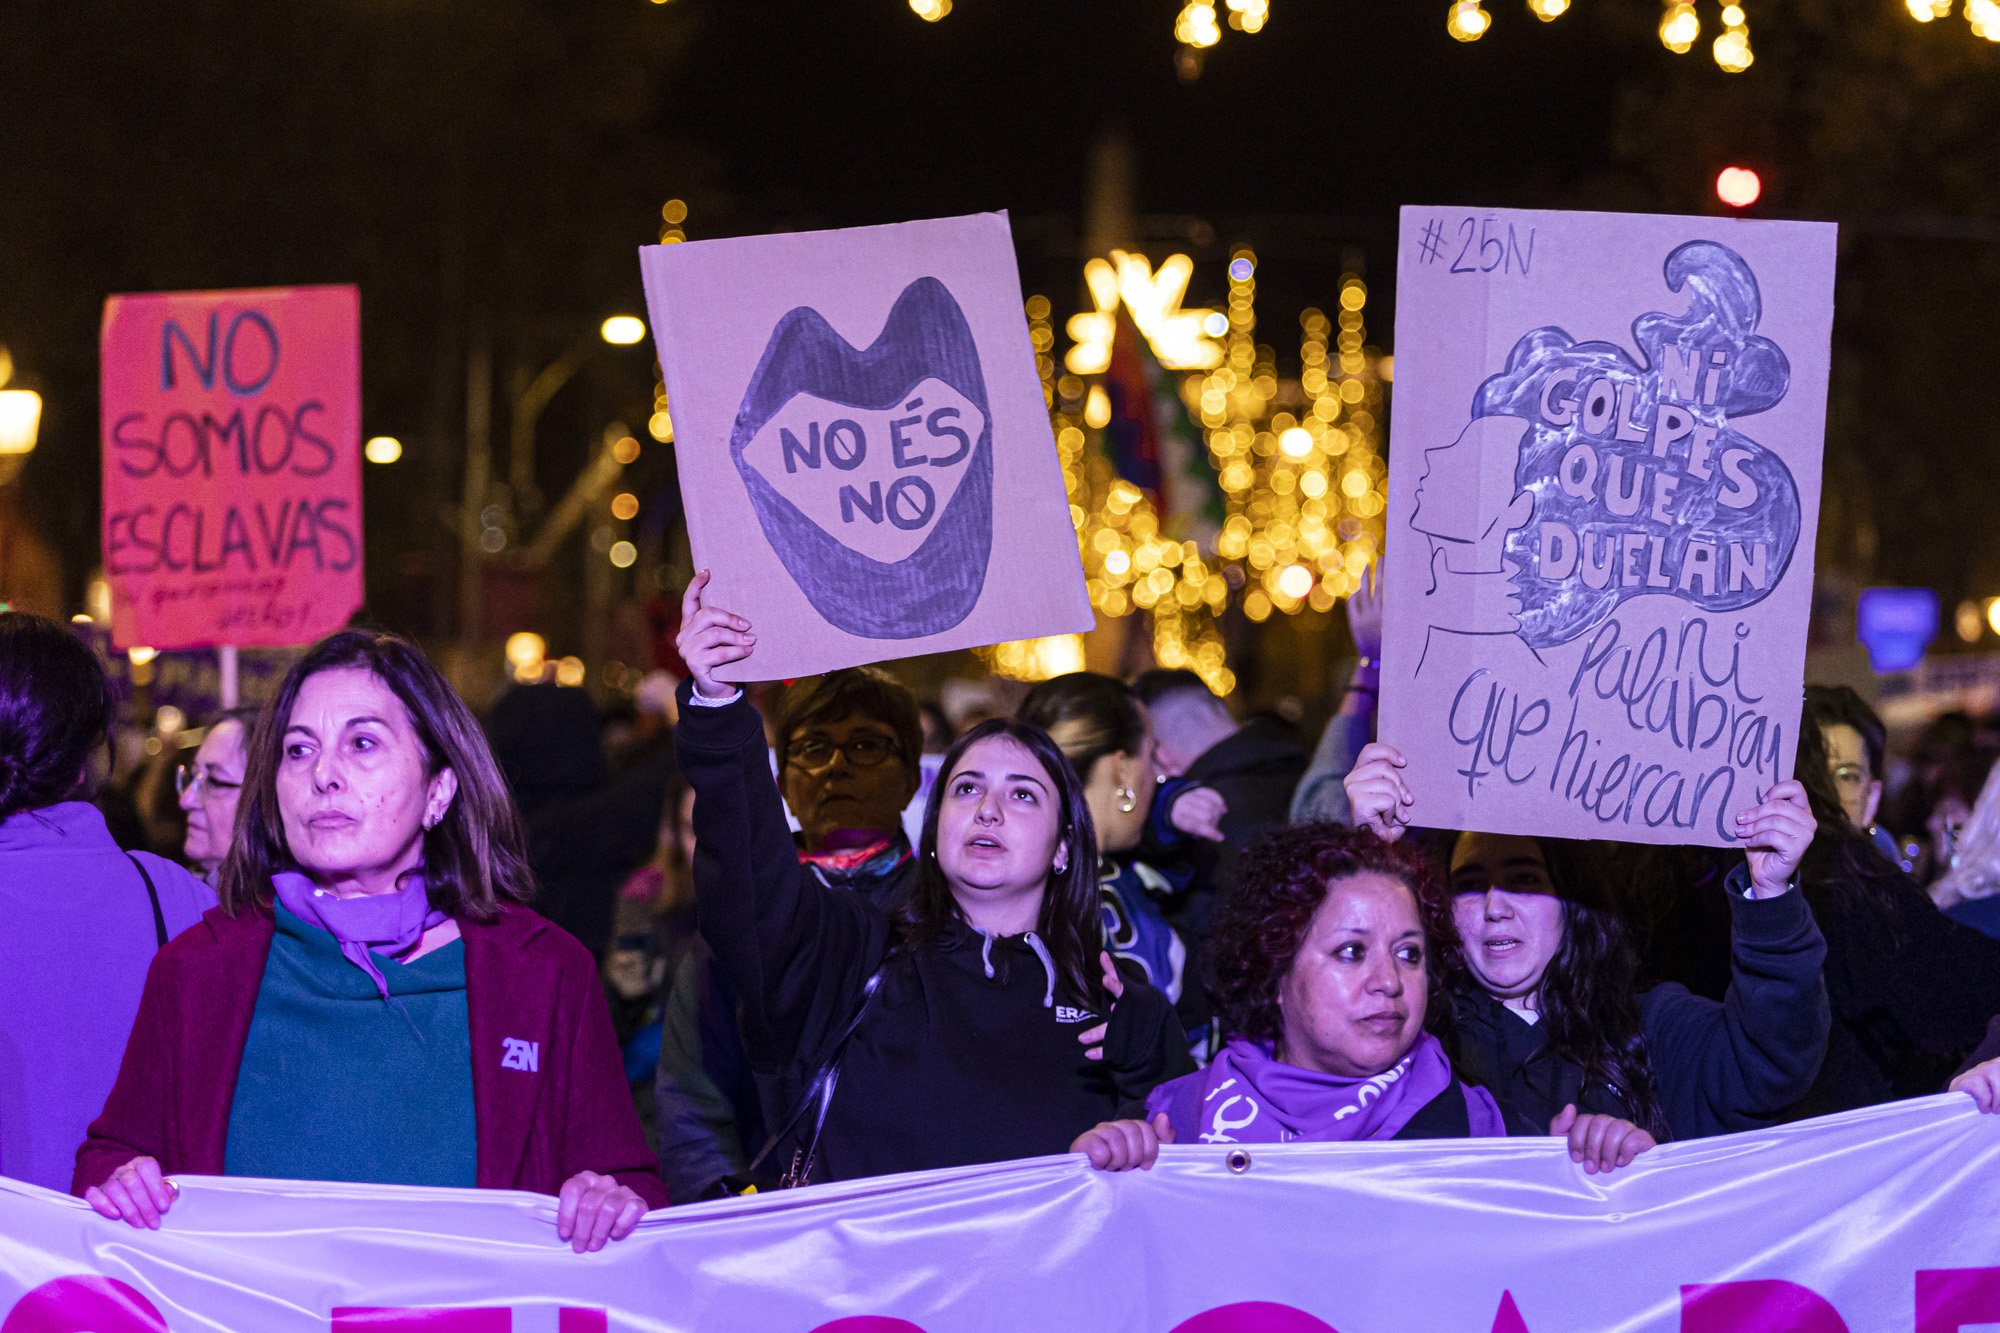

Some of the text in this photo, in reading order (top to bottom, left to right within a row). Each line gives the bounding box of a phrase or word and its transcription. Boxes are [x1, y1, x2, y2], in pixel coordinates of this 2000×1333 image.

[1417, 213, 1537, 276] #25N
[160, 309, 280, 396] NO
[112, 401, 334, 478] SOMOS
[779, 397, 970, 474] NO ÉS
[1540, 367, 1760, 509] GOLPES
[838, 475, 936, 531] NO
[1559, 443, 1681, 528] QUE
[109, 498, 359, 574] ESCLAVAS
[1539, 520, 1769, 597] DUELAN
[1549, 688, 1738, 842] hieran
[501, 1037, 539, 1073] 25N
